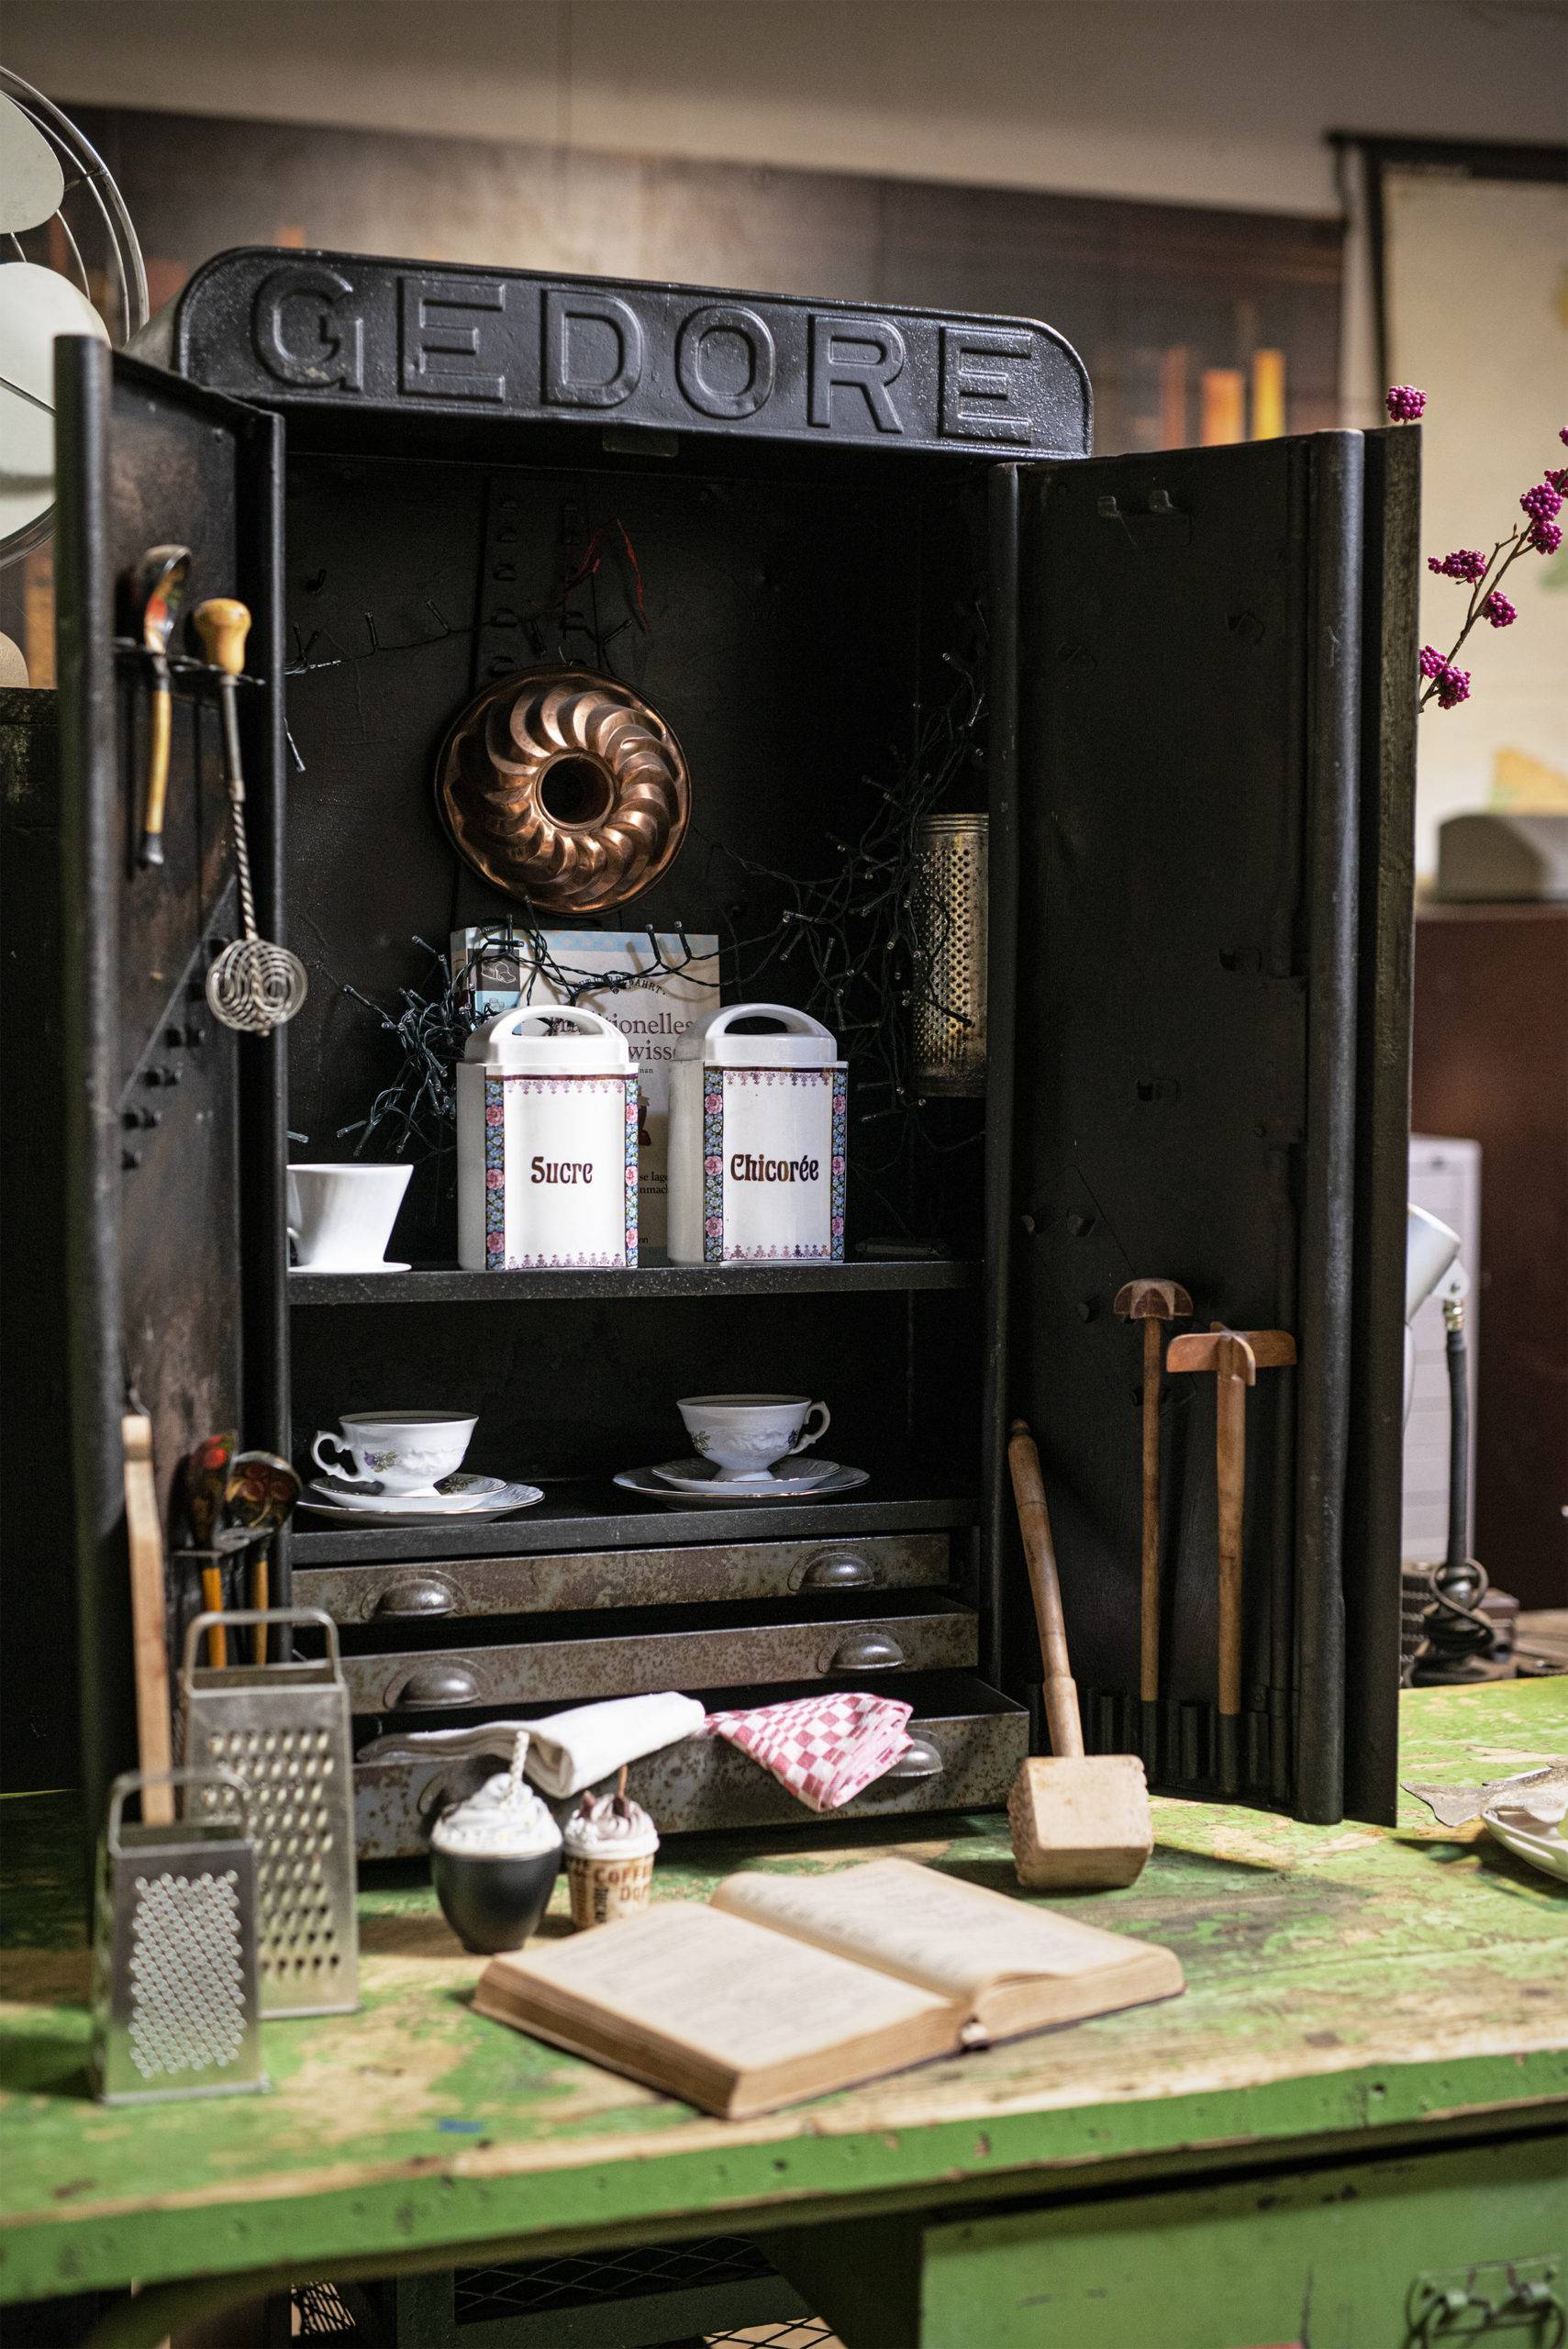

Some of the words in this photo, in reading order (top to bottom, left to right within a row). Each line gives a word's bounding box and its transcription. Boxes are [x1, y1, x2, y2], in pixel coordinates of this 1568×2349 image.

[250, 264, 1036, 446] GEDORE
[530, 1155, 593, 1185] Sucre
[730, 1153, 819, 1183] Chicorée
